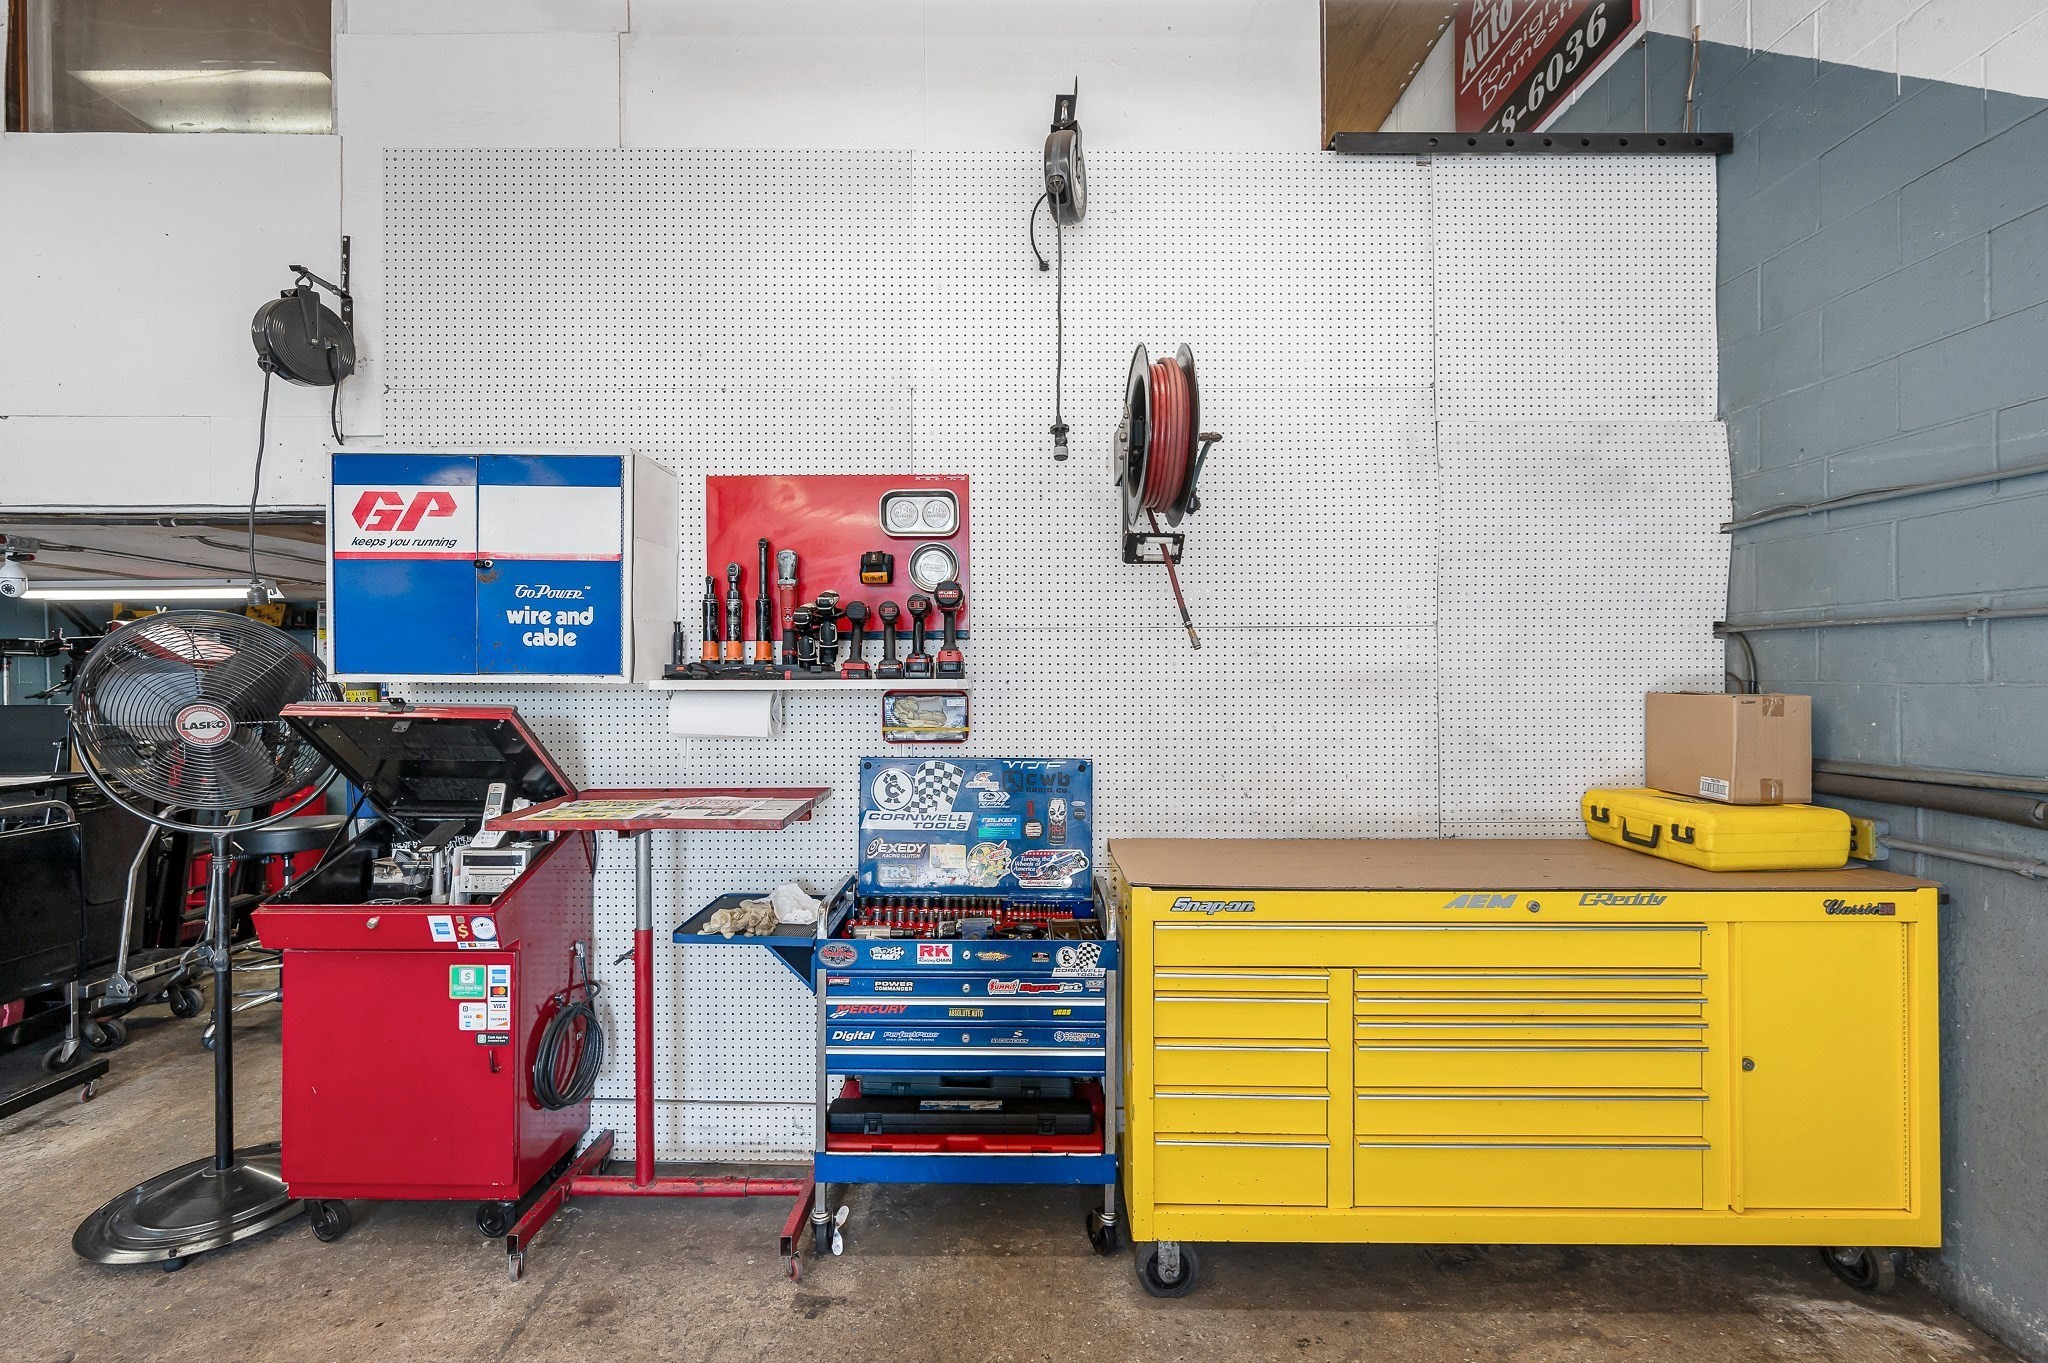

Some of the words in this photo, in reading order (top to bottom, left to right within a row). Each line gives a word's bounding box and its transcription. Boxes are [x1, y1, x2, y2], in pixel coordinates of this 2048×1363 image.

[1462, 0, 1513, 84] Auto
[1487, 3, 1607, 133] 8-6036
[351, 491, 458, 531] GP
[351, 537, 387, 547] keeps
[387, 538, 411, 548] you
[411, 537, 458, 548] running
[506, 605, 552, 625] wire
[555, 606, 594, 626] and
[522, 627, 578, 647] cable
[181, 720, 227, 731] LASKO
[1026, 771, 1071, 787] cwb
[868, 813, 966, 821] CORNWELL
[878, 843, 927, 853] EXEDY
[1170, 897, 1255, 915] Snap-on
[1442, 894, 1518, 909] AEM
[1578, 893, 1668, 906] GReddy
[1823, 899, 1880, 916] Classic
[919, 945, 949, 957] RK
[836, 1005, 908, 1014] MERCURY
[948, 1008, 971, 1017] ABSOLUTE
[971, 1009, 984, 1018] AUTO
[832, 1031, 876, 1041] Digital
